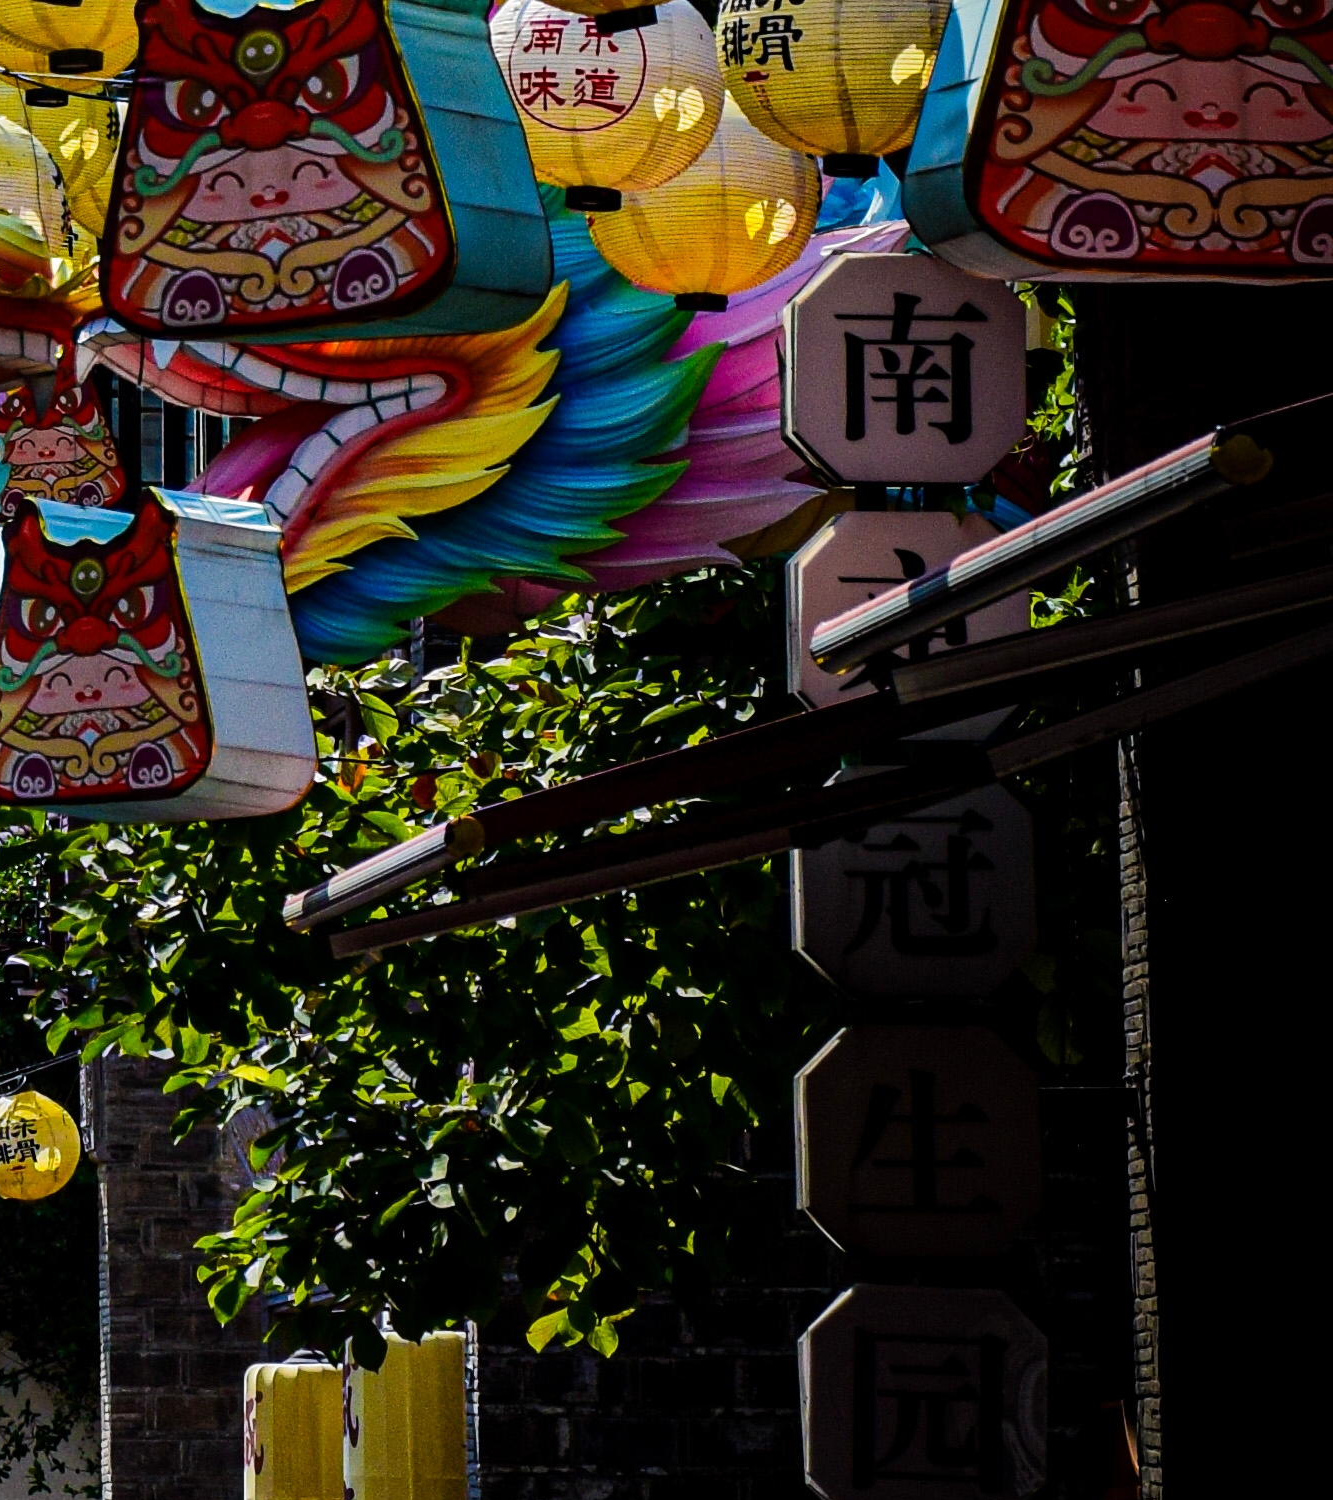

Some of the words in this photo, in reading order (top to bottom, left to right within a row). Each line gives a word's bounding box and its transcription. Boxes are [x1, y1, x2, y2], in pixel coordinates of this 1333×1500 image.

[523, 12, 621, 56] 南京
[722, 14, 803, 72] 排骨
[520, 63, 627, 113] 味道
